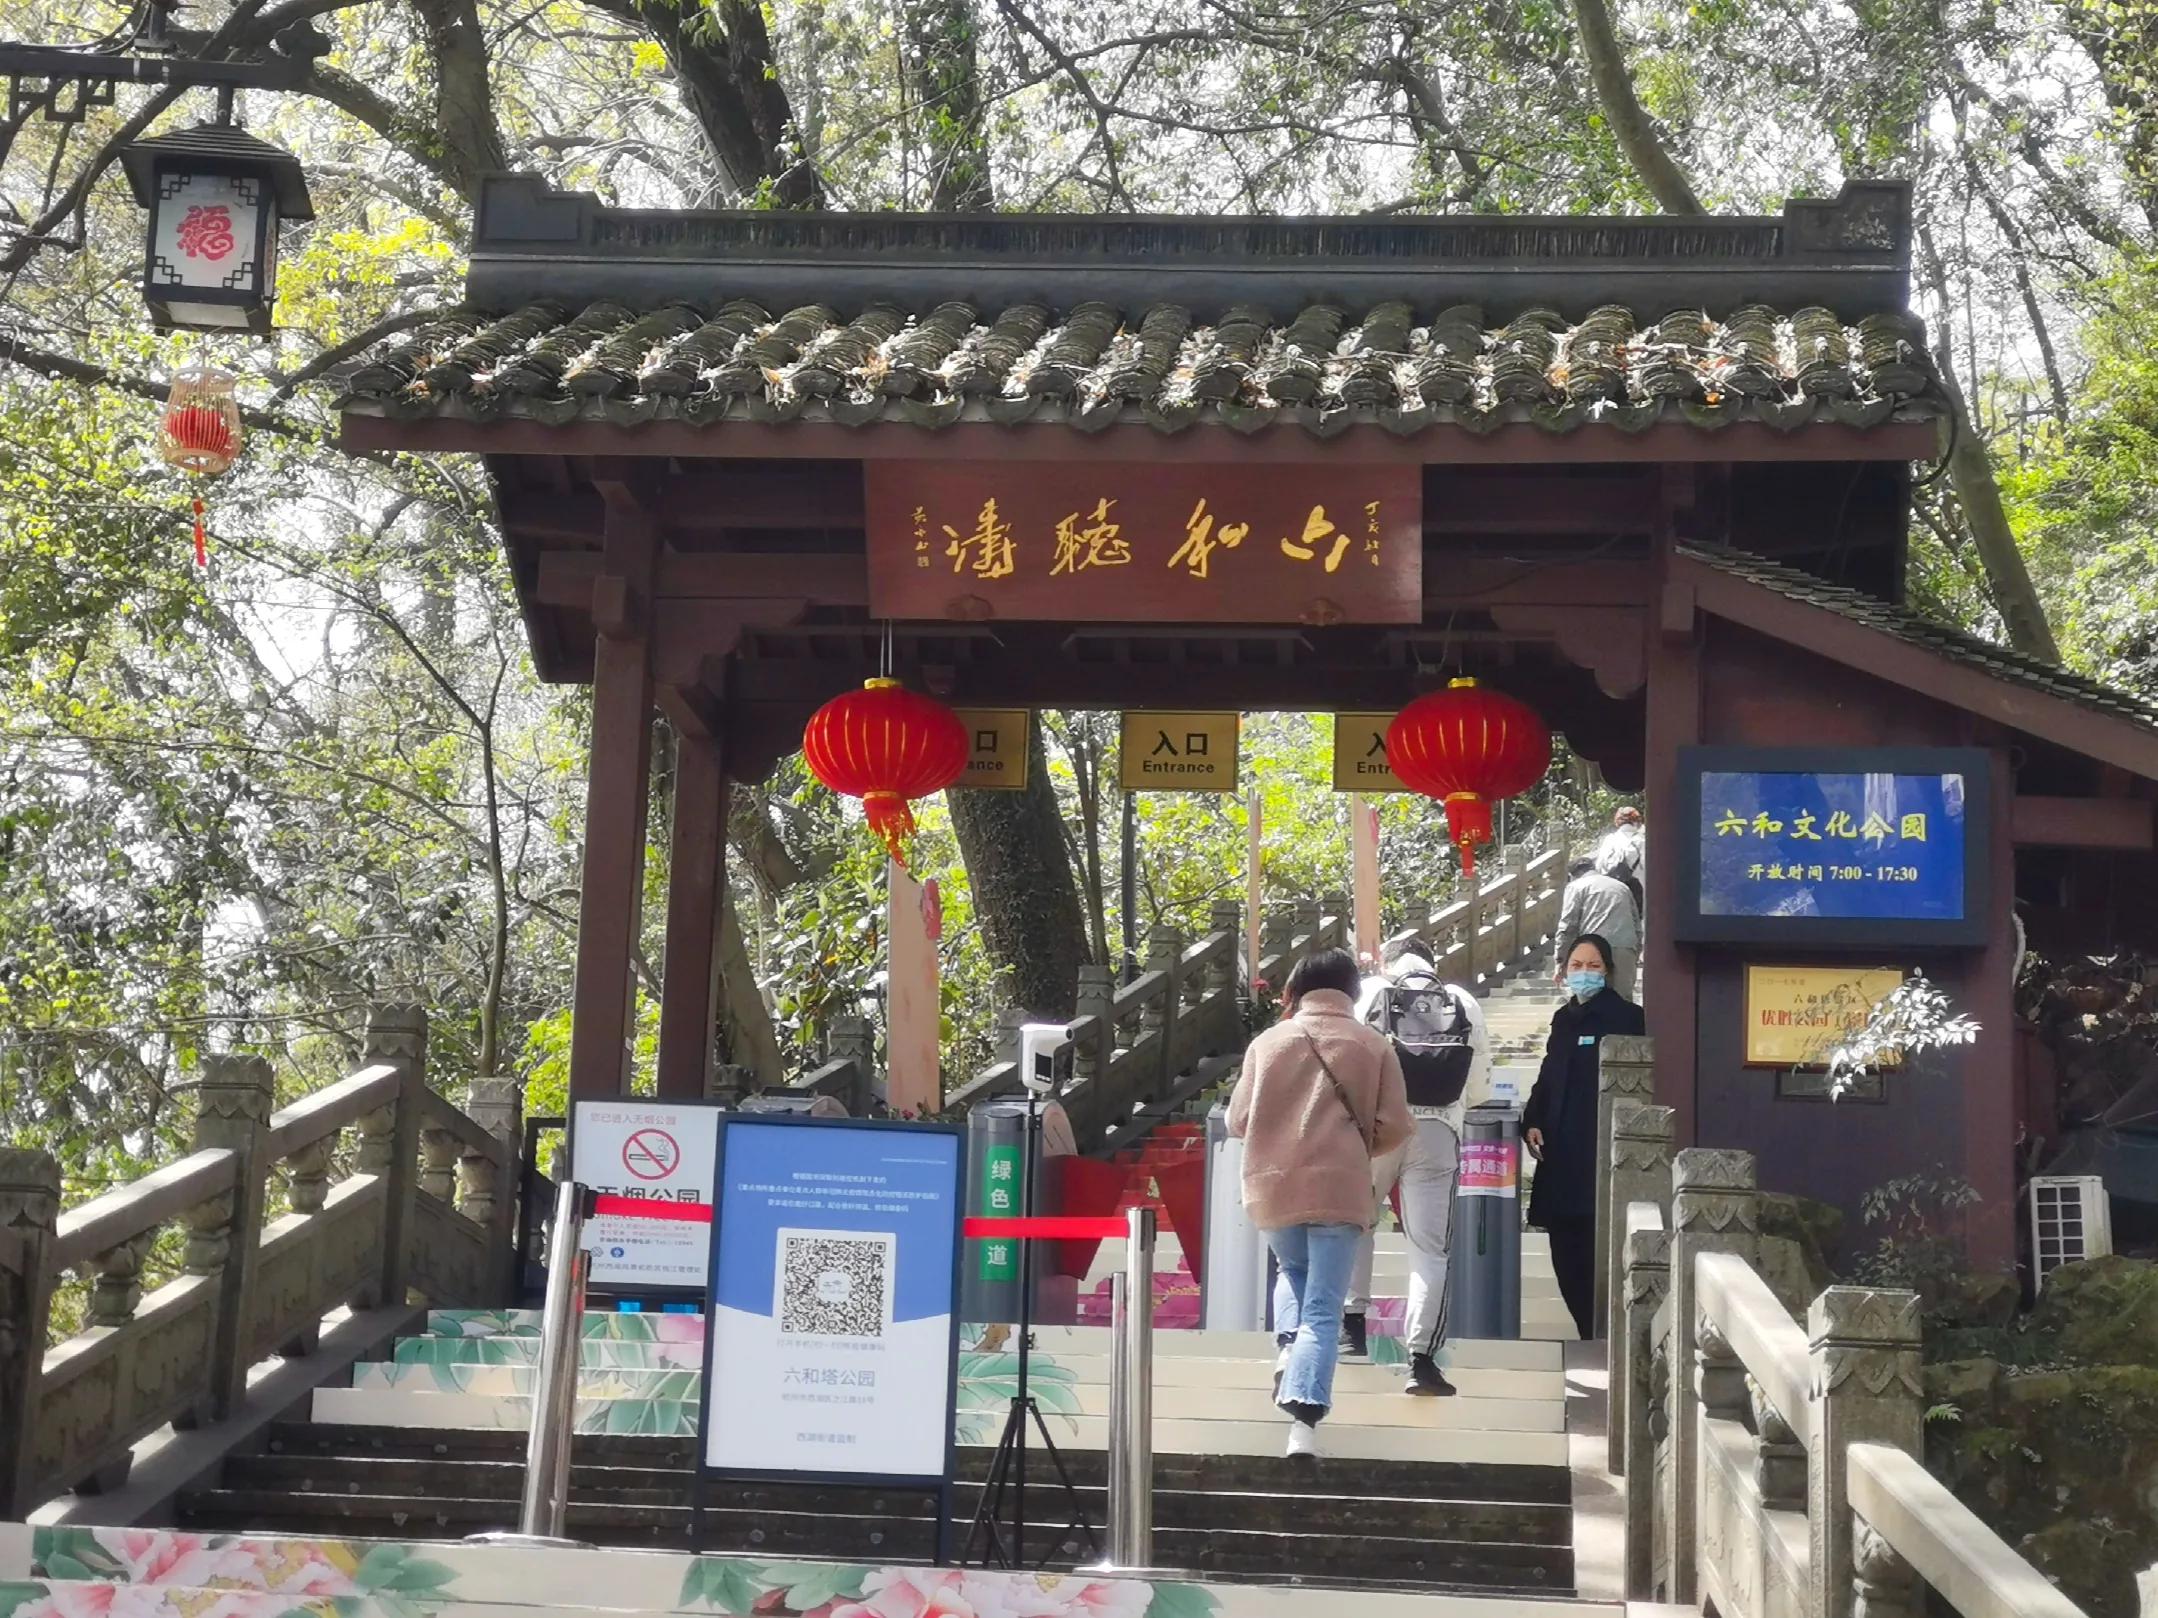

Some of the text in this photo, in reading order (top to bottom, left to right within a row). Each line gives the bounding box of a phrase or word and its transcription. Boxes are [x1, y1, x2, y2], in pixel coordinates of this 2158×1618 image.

[975, 730, 998, 753] 口
[1151, 730, 1209, 756] 入口
[1366, 732, 1388, 757] 入
[967, 759, 1004, 772] ance
[1142, 760, 1215, 774] Entrance
[1356, 761, 1392, 775] Entr
[1714, 808, 1927, 842] 六和文化公园
[1747, 864, 1823, 882] 开放时间
[1829, 866, 1862, 880] 7:00
[1877, 866, 1918, 881] 17:30
[987, 1159, 1012, 1266] 绿色道
[783, 1367, 876, 1388] 六和塔公园
